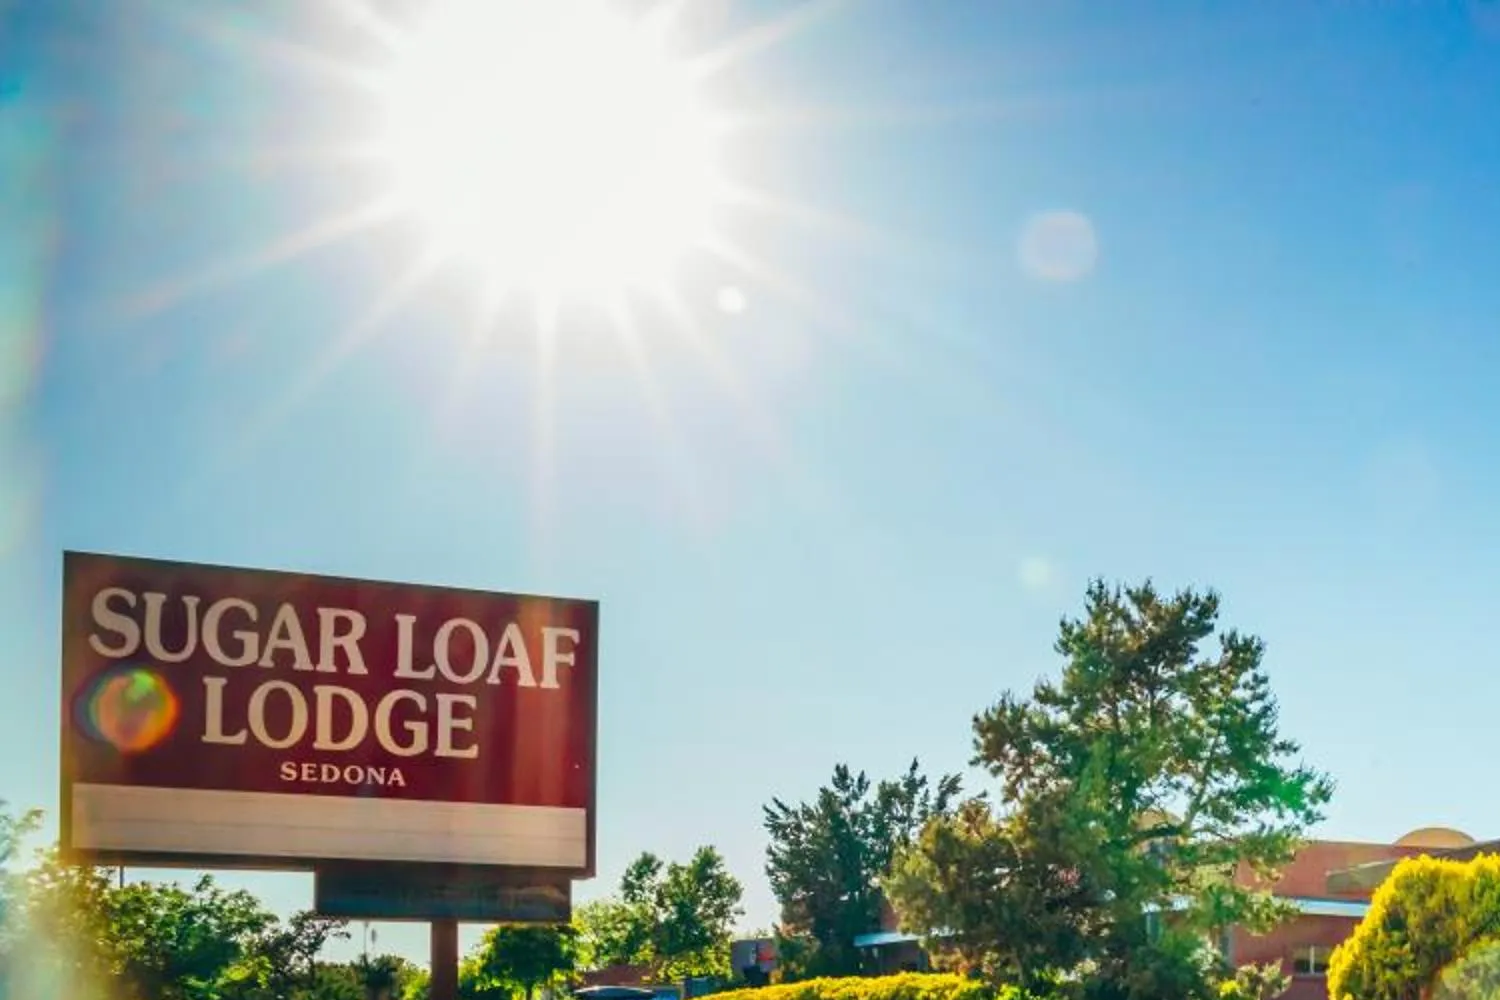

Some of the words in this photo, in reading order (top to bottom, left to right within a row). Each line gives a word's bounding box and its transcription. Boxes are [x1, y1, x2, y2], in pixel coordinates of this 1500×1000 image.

[88, 587, 369, 675] SUGAR
[393, 613, 581, 690] LOAF
[201, 676, 480, 759] LODGE
[280, 761, 406, 787] SEDONA
